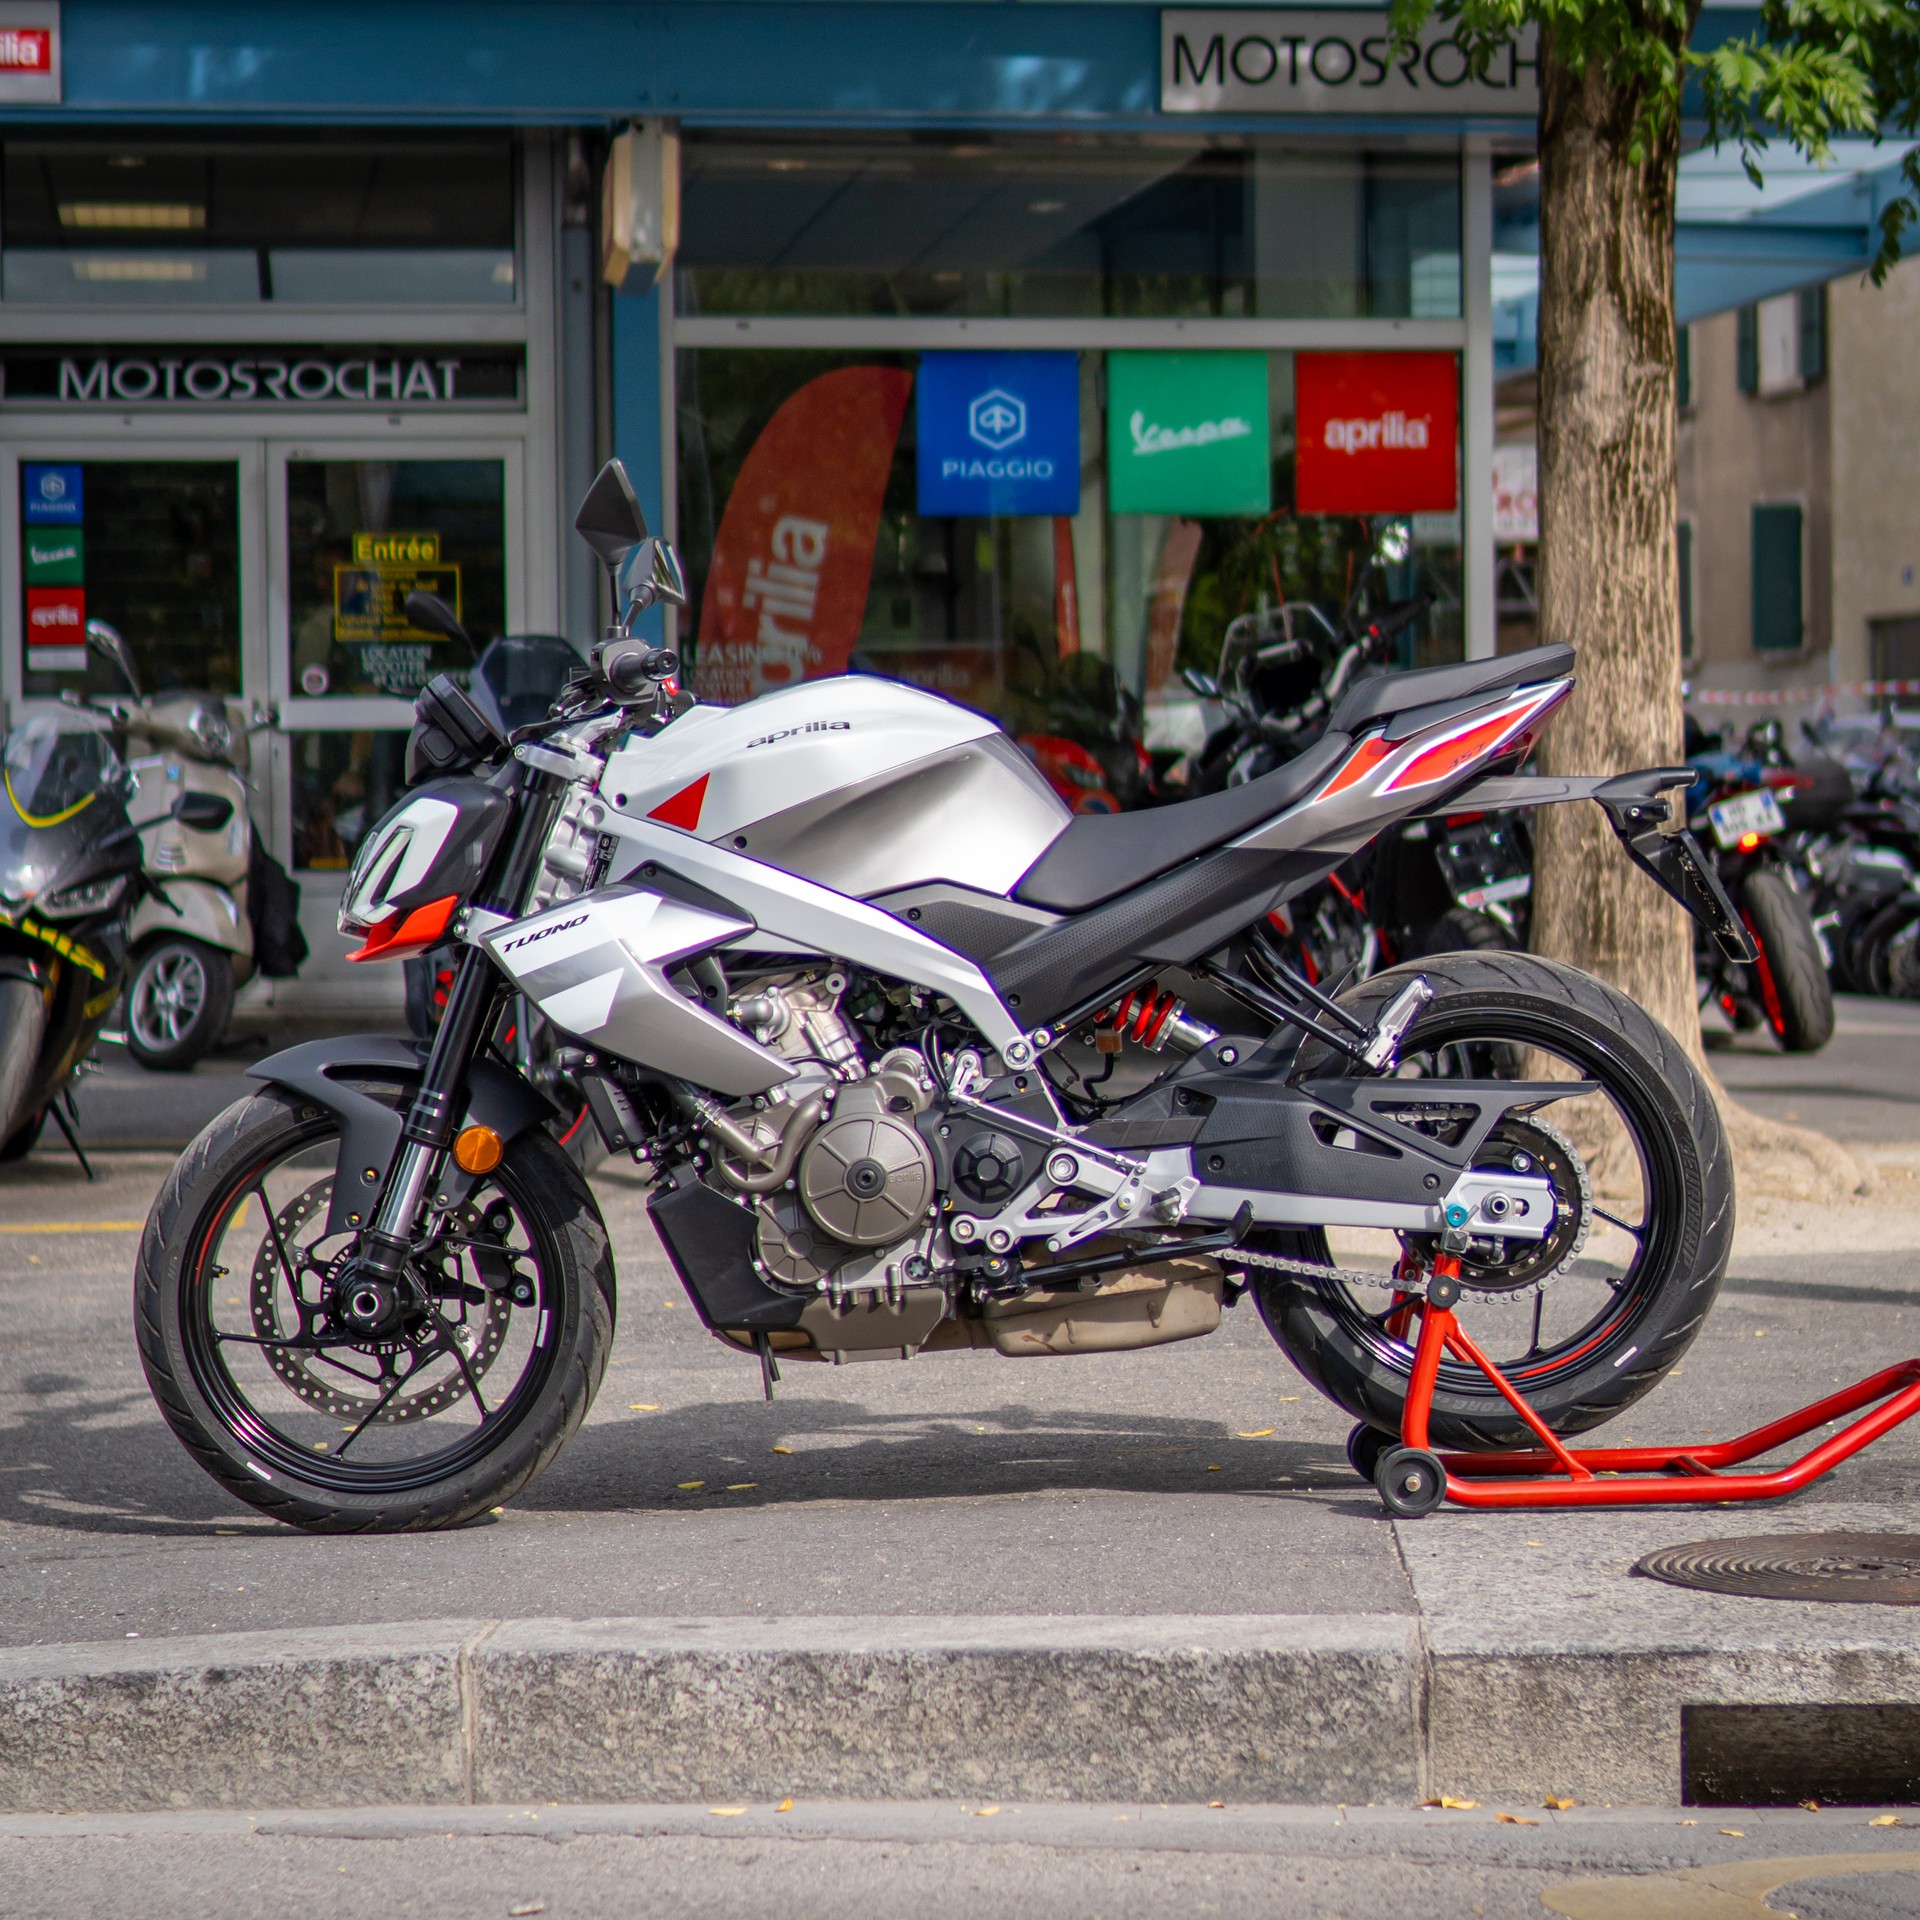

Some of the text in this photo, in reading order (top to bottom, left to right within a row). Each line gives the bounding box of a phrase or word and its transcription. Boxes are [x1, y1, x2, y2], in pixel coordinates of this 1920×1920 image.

[1173, 33, 1539, 88] MOTOSROCH
[60, 359, 461, 400] MOTOSROCHAT
[1324, 410, 1431, 454] aprilia
[942, 460, 1054, 478] PIAGGIO
[356, 534, 435, 560] Entrée
[746, 721, 851, 748] aprilia
[503, 914, 590, 953] TUONO
[888, 1168, 921, 1185] aprilia
